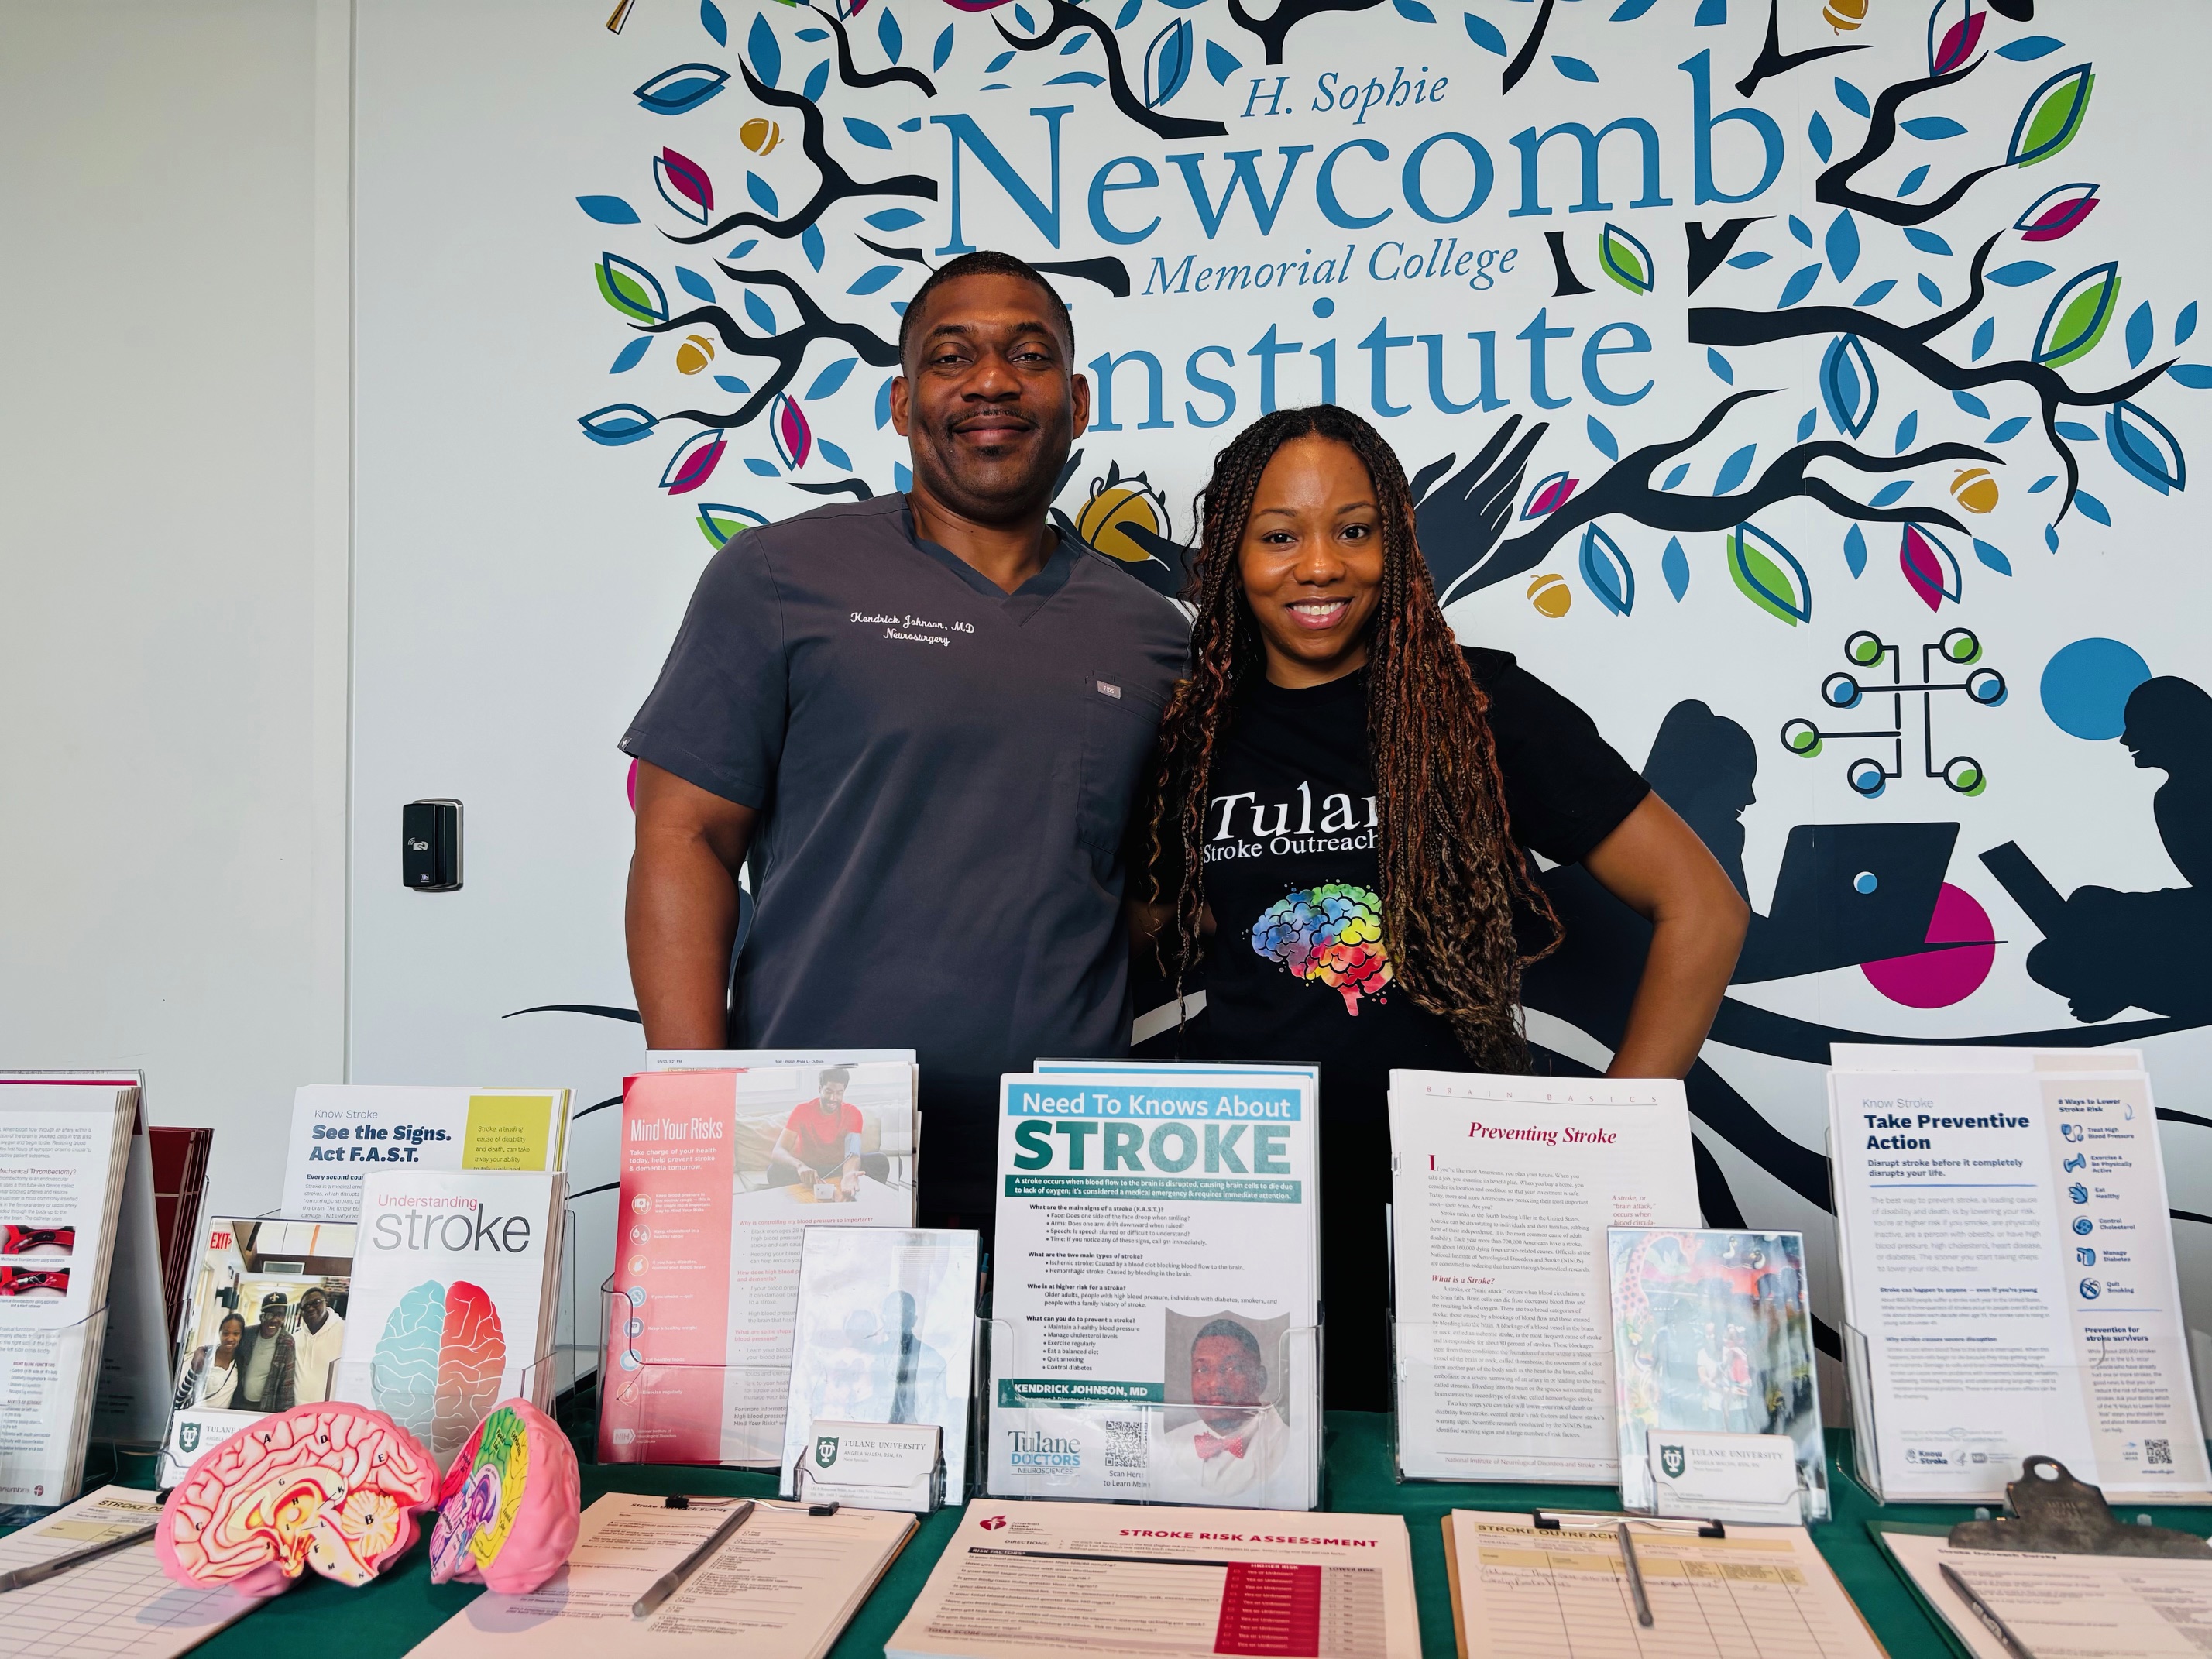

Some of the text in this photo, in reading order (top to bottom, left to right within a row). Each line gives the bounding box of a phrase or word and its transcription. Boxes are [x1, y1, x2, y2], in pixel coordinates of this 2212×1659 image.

[1241, 67, 1448, 124] H. Sophie
[930, 47, 1785, 256] Newcomb
[1141, 239, 1517, 297] Memorial College
[1065, 297, 1654, 433] nstitute
[850, 612, 974, 634] Kendrick Johnson, MD
[883, 628, 950, 647] Neurosurgery
[1204, 829, 1379, 864] Stroke Outreach
[1022, 1092, 1291, 1118] Need To Knows About
[1862, 1097, 1934, 1108] Know Stroke
[314, 1109, 378, 1118] Know Stroke
[1864, 1113, 2031, 1130] Take Preventive
[311, 1125, 452, 1145] See the Signs.
[630, 1117, 723, 1142] Mind Your Risks
[1468, 1121, 1617, 1146] Preventing Stroke
[1013, 1119, 1291, 1174] STROKE
[1867, 1135, 1931, 1150] Action
[309, 1146, 419, 1162] Act F.A.S.T.
[1869, 1169, 1905, 1177] disrupts
[1166, 1180, 1200, 1189] disrupted,
[1200, 1180, 1225, 1190] causing
[377, 1194, 478, 1211] Understanding
[373, 1203, 531, 1253] stroke
[210, 1232, 231, 1249] EXIT
[1014, 1384, 1148, 1396] KENDRICK JOHNSON, MD
[263, 1434, 272, 1444] A
[320, 1434, 328, 1444] D
[1008, 1431, 1081, 1454] Tulane
[378, 1453, 385, 1462] E
[1011, 1454, 1080, 1466] DOCTORS
[1690, 1448, 1783, 1460] TULANE UNIVERSITY
[99, 1500, 148, 1510] STROKE
[195, 1521, 204, 1531] C
[365, 1514, 374, 1525] B
[1119, 1529, 1379, 1547] STROKE RISK ASSESSMENT
[1478, 1525, 1618, 1540] STROKE OUTREACH
